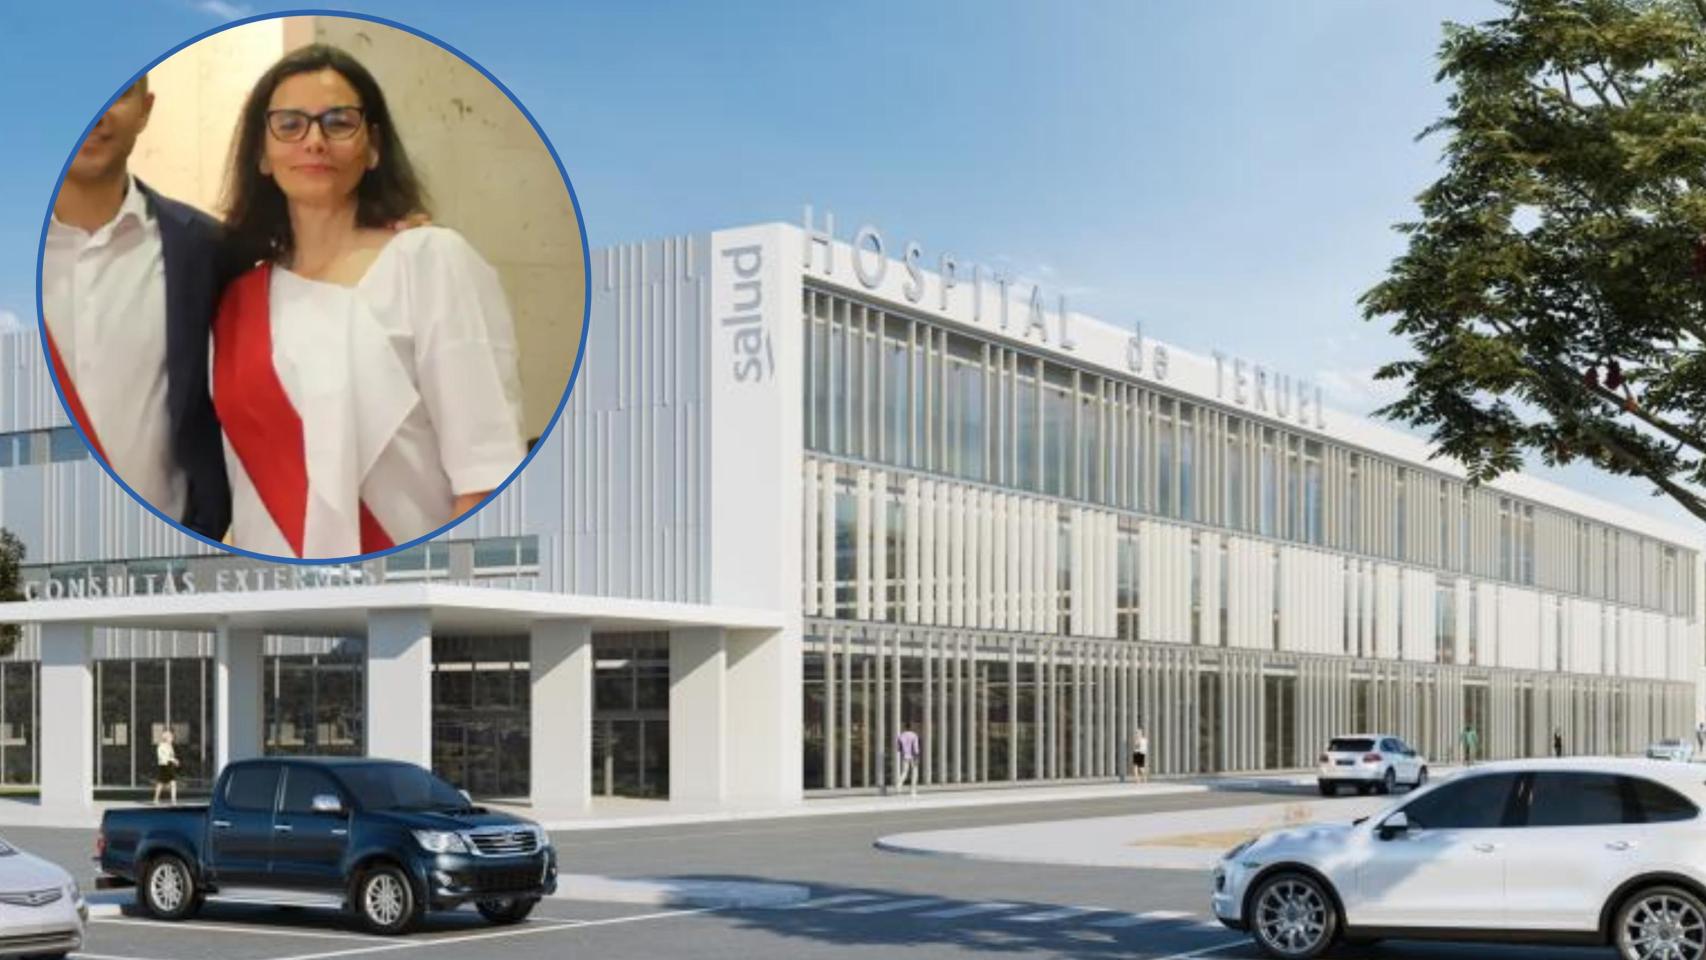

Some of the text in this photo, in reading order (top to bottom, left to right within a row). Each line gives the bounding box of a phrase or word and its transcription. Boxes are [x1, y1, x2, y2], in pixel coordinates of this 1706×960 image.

[721, 244, 762, 383] salud
[803, 204, 1327, 429] HOSPITAL de TERUEL
[25, 565, 197, 601] CONSULTAS
